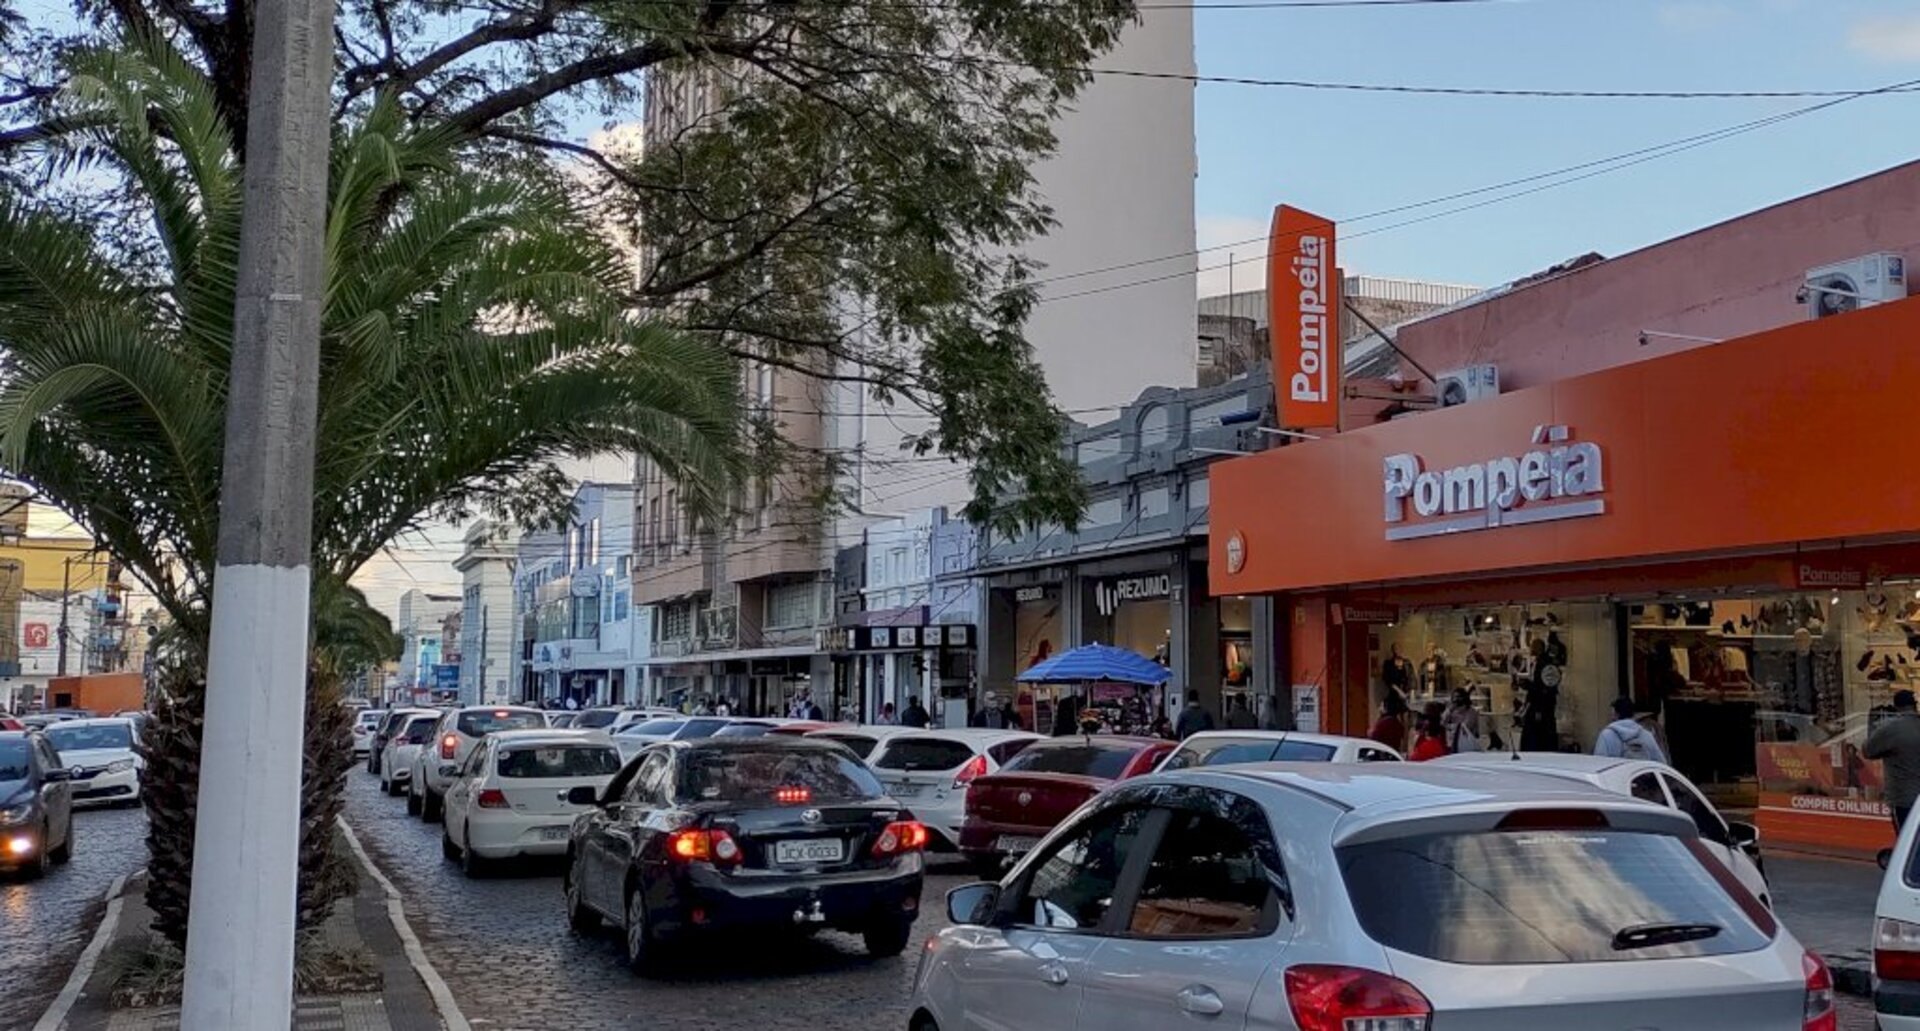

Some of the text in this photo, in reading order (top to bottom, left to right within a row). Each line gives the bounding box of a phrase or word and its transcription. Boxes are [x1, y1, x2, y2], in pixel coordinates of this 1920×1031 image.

[1291, 236, 1326, 402] Pompéia
[1384, 424, 1605, 529] Pompéia
[1117, 574, 1169, 599] REZUMO
[1792, 796, 1836, 811] COMPRE
[1837, 800, 1880, 815] ONLINE
